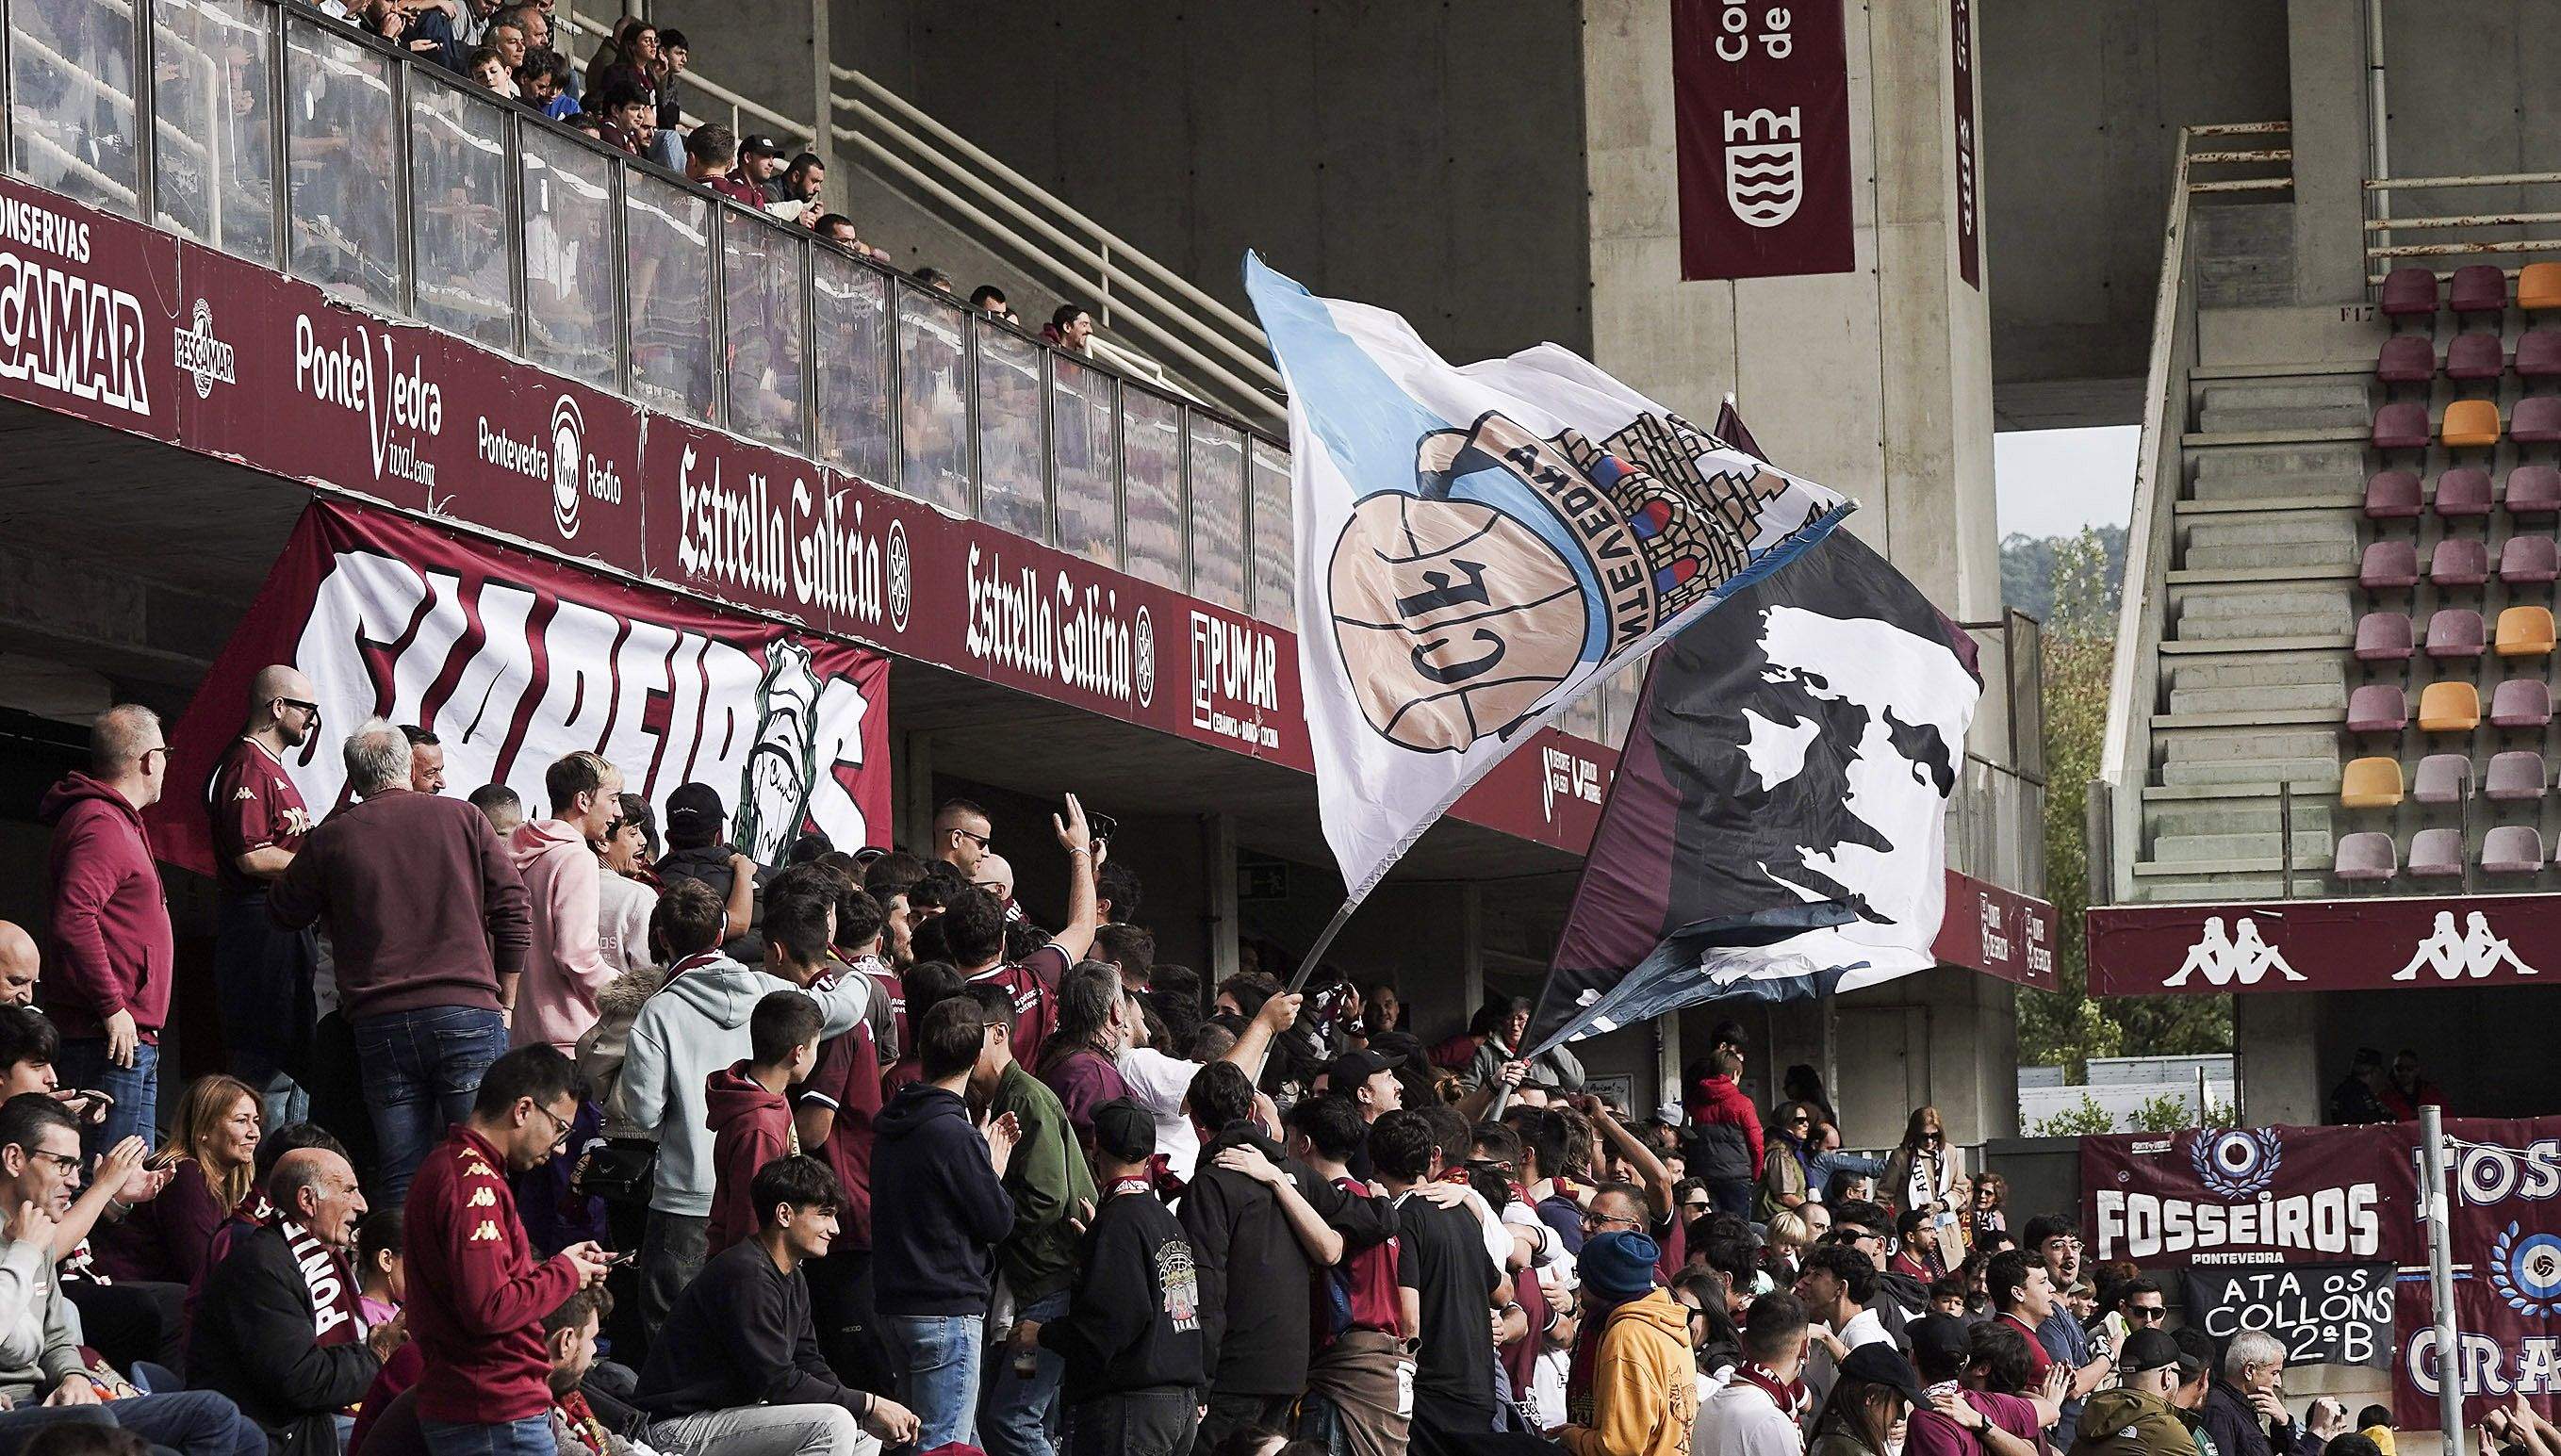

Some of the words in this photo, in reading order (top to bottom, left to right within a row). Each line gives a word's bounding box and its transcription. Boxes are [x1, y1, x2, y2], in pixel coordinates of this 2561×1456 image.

[1759, 8, 1791, 59] de
[478, 416, 549, 482] Pontevedra
[556, 443, 577, 489] Viva
[587, 453, 621, 505] Radio
[679, 443, 787, 599] Estrella
[791, 478, 882, 626] Galicia
[965, 540, 1054, 680] Estrella
[1057, 570, 1131, 702] Galicia
[1210, 616, 1278, 712] PUMAR
[2192, 1252, 2285, 1265] PONTEVEDRA
[2223, 1271, 2301, 1304] ATA
[2205, 1286, 2394, 1336] COLLONS
